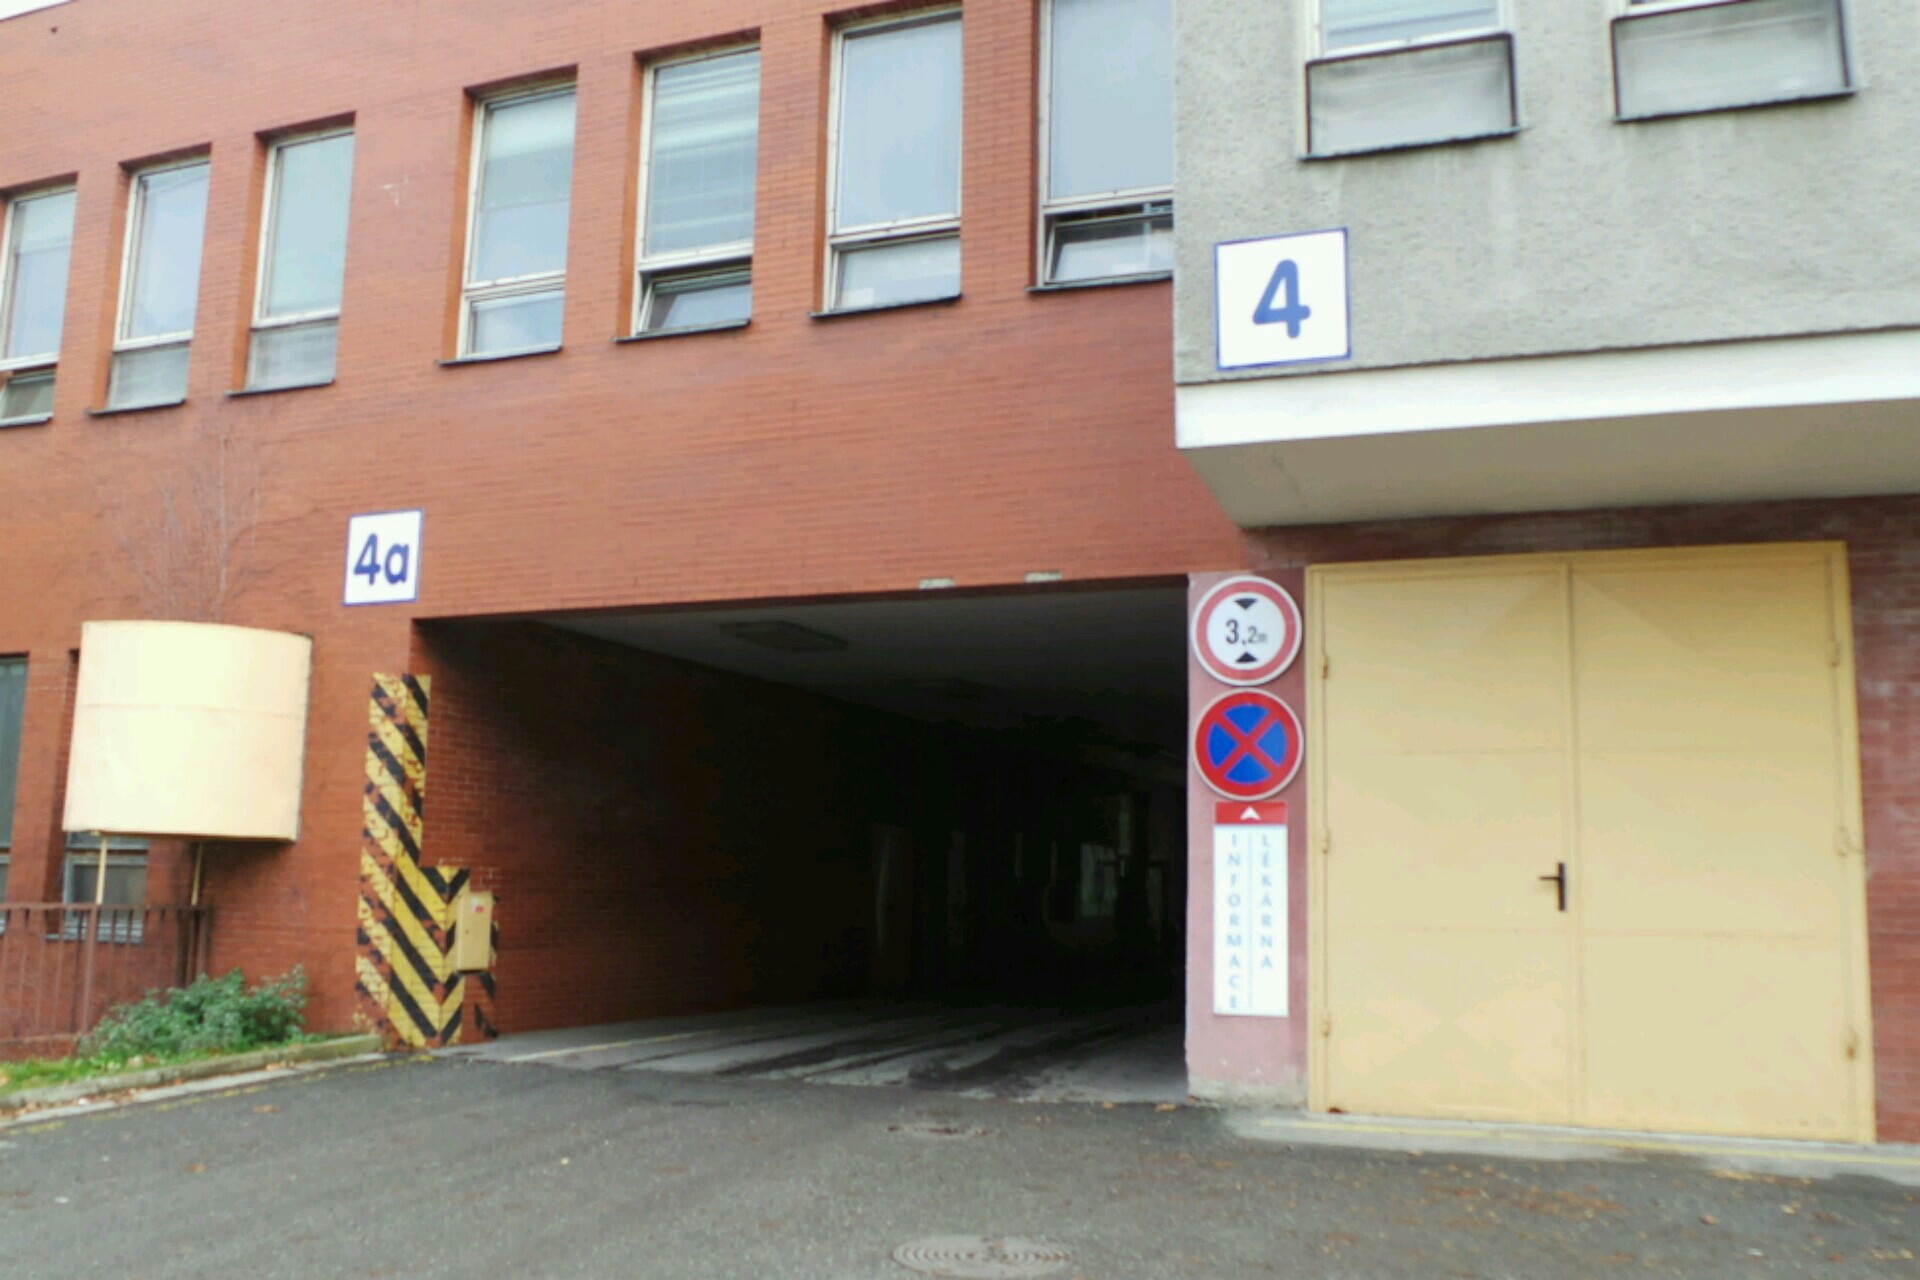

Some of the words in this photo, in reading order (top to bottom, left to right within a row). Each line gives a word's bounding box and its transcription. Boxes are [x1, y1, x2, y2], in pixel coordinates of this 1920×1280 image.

[1252, 259, 1311, 339] 4
[353, 532, 409, 585] 4a
[1227, 833, 1242, 1009] INFORMACE
